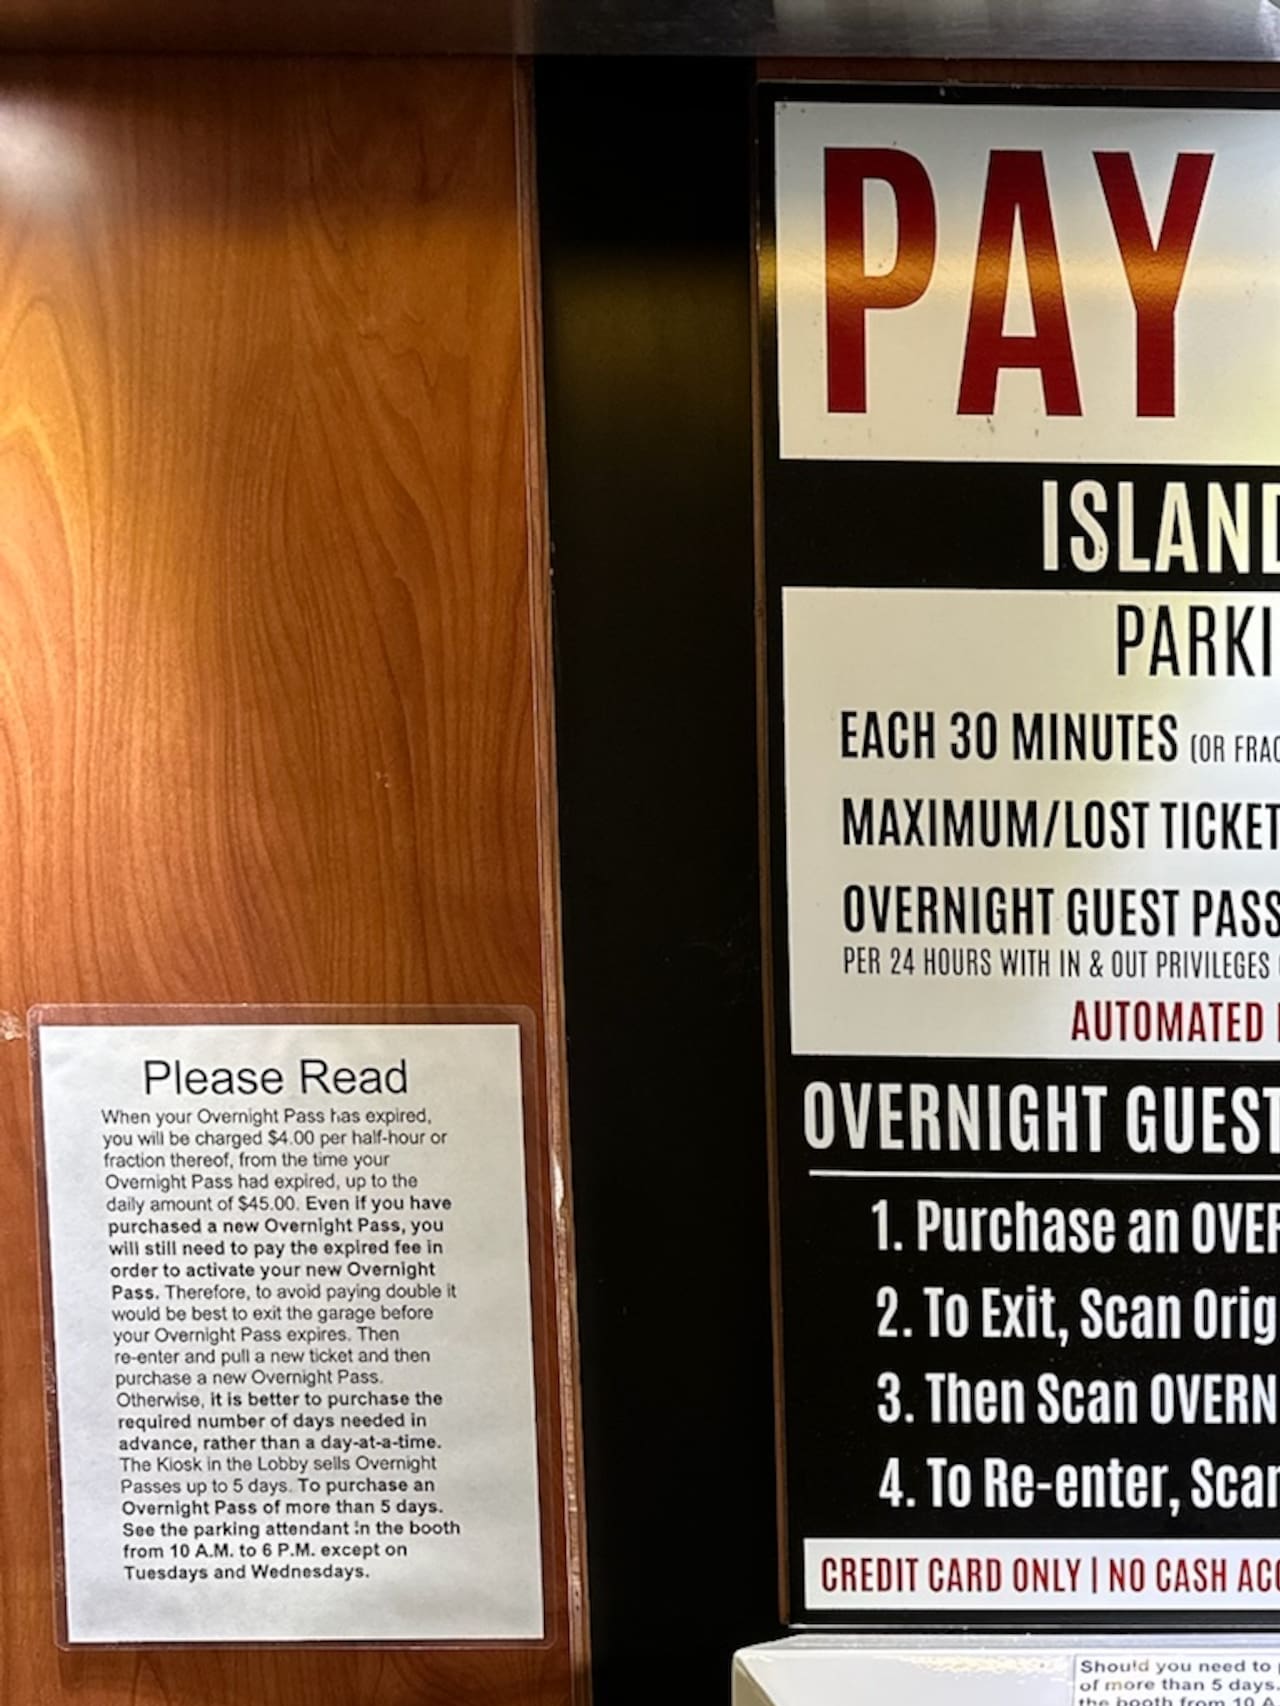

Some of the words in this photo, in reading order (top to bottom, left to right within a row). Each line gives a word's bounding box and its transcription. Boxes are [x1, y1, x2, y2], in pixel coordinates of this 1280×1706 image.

[822, 146, 1214, 418] PAY
[841, 711, 935, 759] EACH
[950, 712, 997, 760] 30
[1013, 713, 1177, 762] MINUTES
[1191, 734, 1224, 764] (OR
[843, 798, 1150, 848] MAXIMUM/LOST
[844, 885, 1054, 935] OVERNIGHT
[1067, 888, 1179, 936] GUEST
[844, 946, 880, 974] PER
[891, 947, 914, 975] 24
[924, 948, 991, 976] HOURS
[1000, 948, 1050, 977] WITH
[1060, 949, 1080, 977] IN
[1090, 950, 1103, 978] &
[1112, 950, 1148, 978] OUT
[1157, 951, 1270, 979] PRIVILEGES
[1072, 1000, 1263, 1042] AUTOMATED
[145, 1060, 283, 1094] Please
[300, 1058, 407, 1094] Read
[101, 1110, 150, 1124] When
[156, 1112, 192, 1128] your
[197, 1108, 278, 1127] Overnight
[284, 1108, 325, 1123] Pass
[330, 1108, 360, 1123] has
[366, 1108, 431, 1126] expired,
[804, 1082, 1107, 1152] OVERNIGHT
[872, 1200, 902, 1250] 1.
[918, 1200, 1115, 1253] Purchase
[1128, 1209, 1178, 1253] an
[877, 1286, 912, 1337] 2.
[924, 1287, 968, 1337] To
[982, 1285, 1068, 1347] Exit,
[1081, 1288, 1180, 1339] Scan
[879, 1458, 915, 1507] 4.
[926, 1458, 971, 1507] To
[984, 1458, 1180, 1517] Re-enter,
[822, 1558, 918, 1592] CREDIT
[929, 1558, 1001, 1592] CARD
[1014, 1558, 1080, 1592] ONLY
[1110, 1558, 1144, 1592] NO
[1157, 1558, 1226, 1592] CASH
